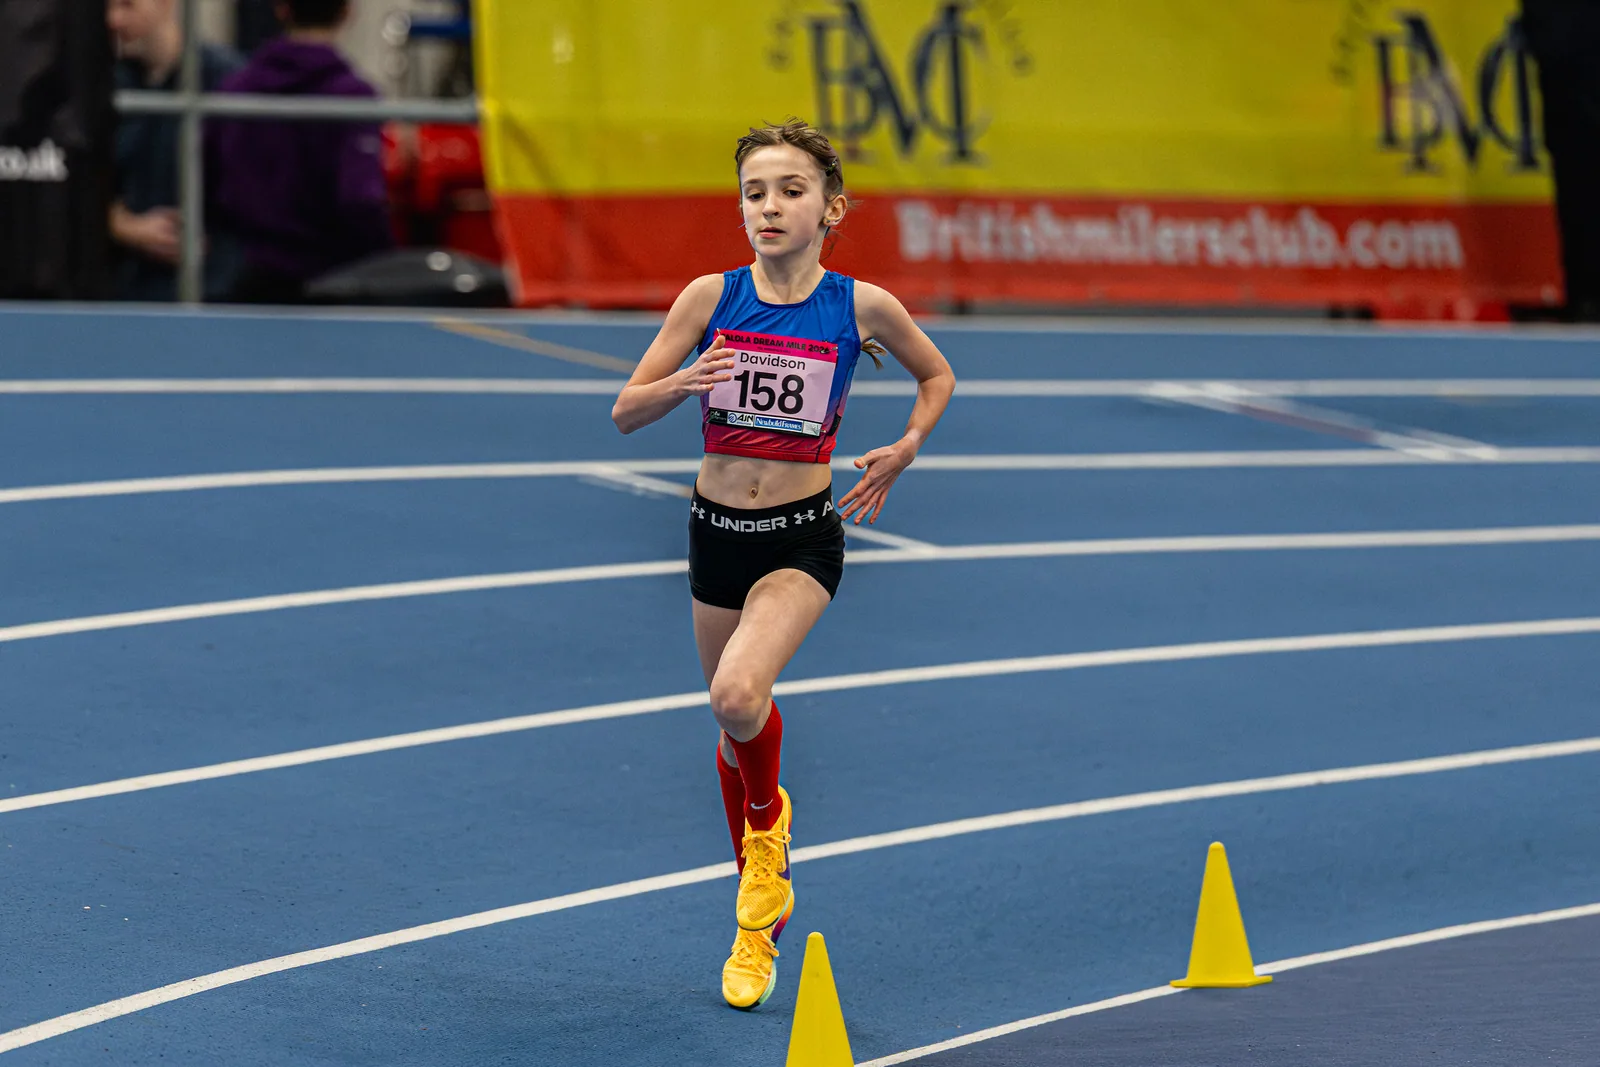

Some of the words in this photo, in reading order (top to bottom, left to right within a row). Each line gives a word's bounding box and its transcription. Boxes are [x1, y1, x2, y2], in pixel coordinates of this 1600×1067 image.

[896, 200, 1464, 268] Britishmilersclub.com
[753, 337, 784, 348] DREAM
[786, 341, 806, 351] MILE
[740, 352, 806, 370] Davidson
[734, 370, 804, 415] 158
[710, 513, 788, 532] UNDER
